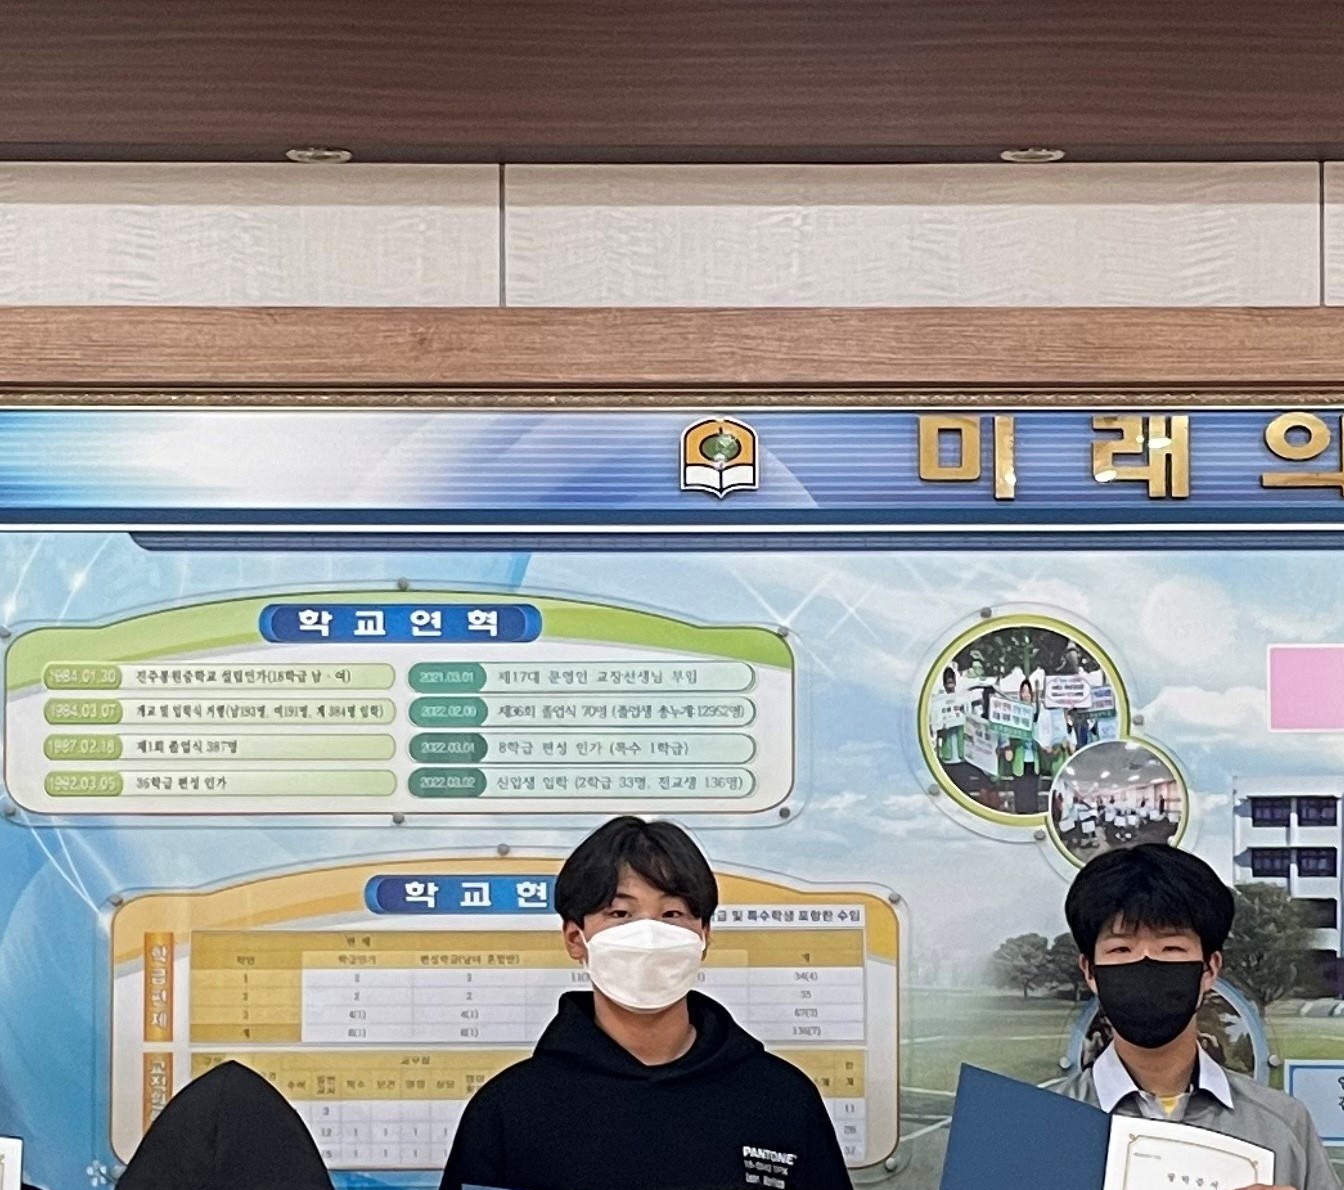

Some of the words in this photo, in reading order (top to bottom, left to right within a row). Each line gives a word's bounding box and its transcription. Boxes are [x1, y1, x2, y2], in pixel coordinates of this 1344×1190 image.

[298, 608, 498, 637] 학교연혁
[498, 670, 540, 685] 제17대
[597, 670, 663, 685] 교장선생님
[732, 909, 743, 922] 및
